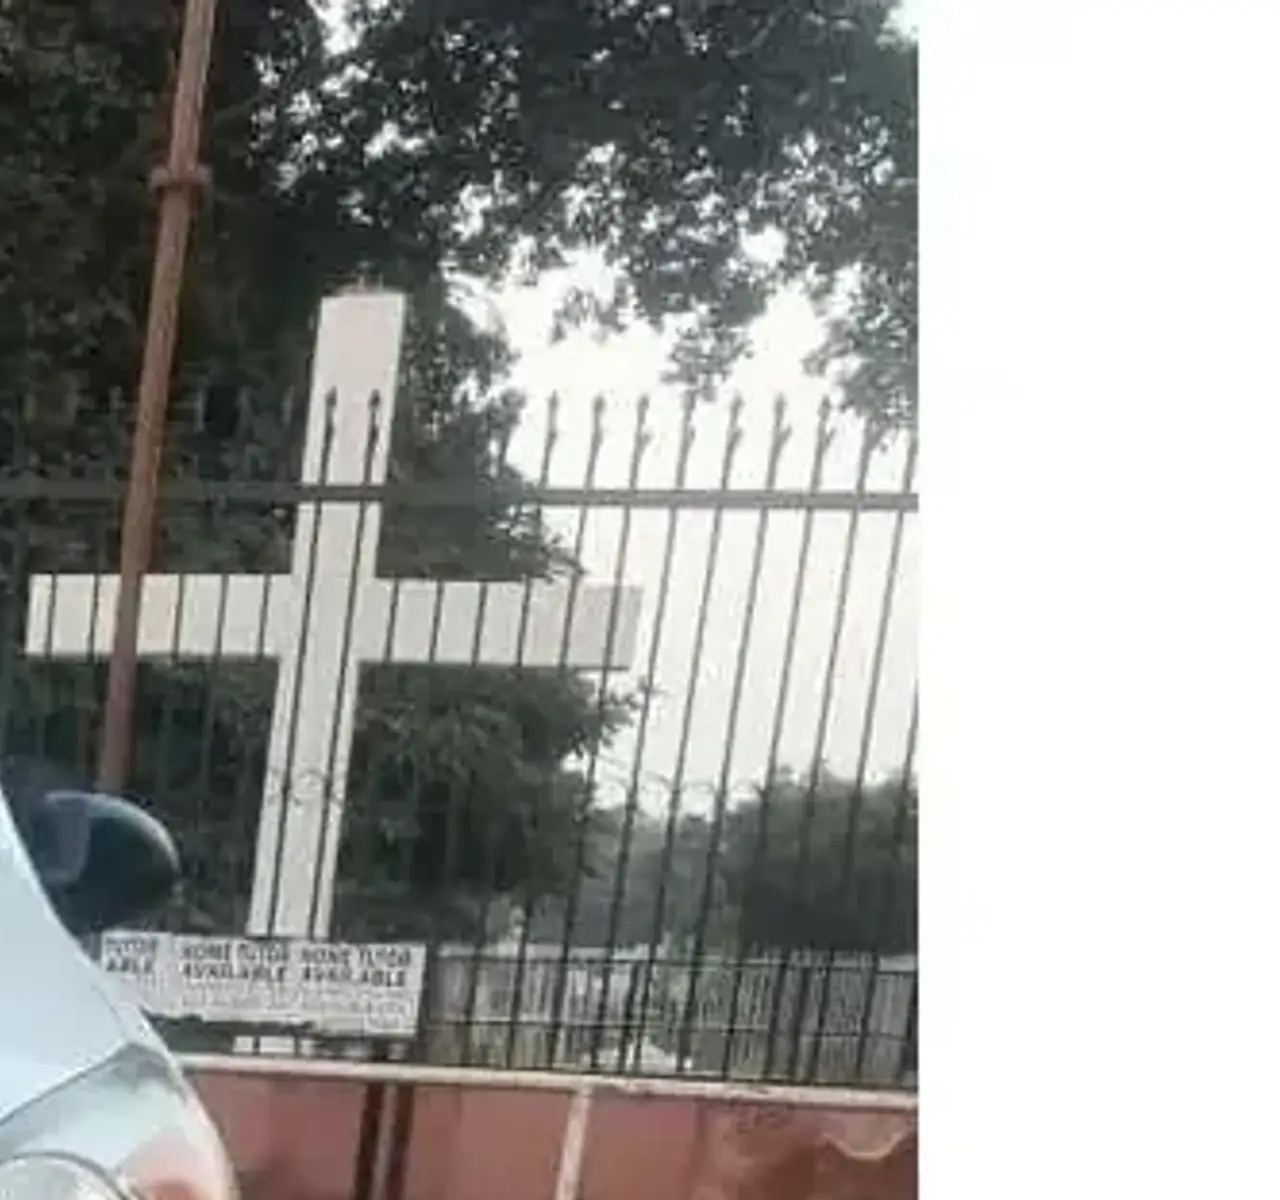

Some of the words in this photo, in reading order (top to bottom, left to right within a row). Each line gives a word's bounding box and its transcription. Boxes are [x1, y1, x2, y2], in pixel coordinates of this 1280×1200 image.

[180, 943, 231, 962] HOME
[301, 947, 349, 966] HOME
[358, 948, 412, 967] TUTOR
[180, 963, 288, 982] AVAILABLE
[301, 966, 406, 988] AVAILABLE
